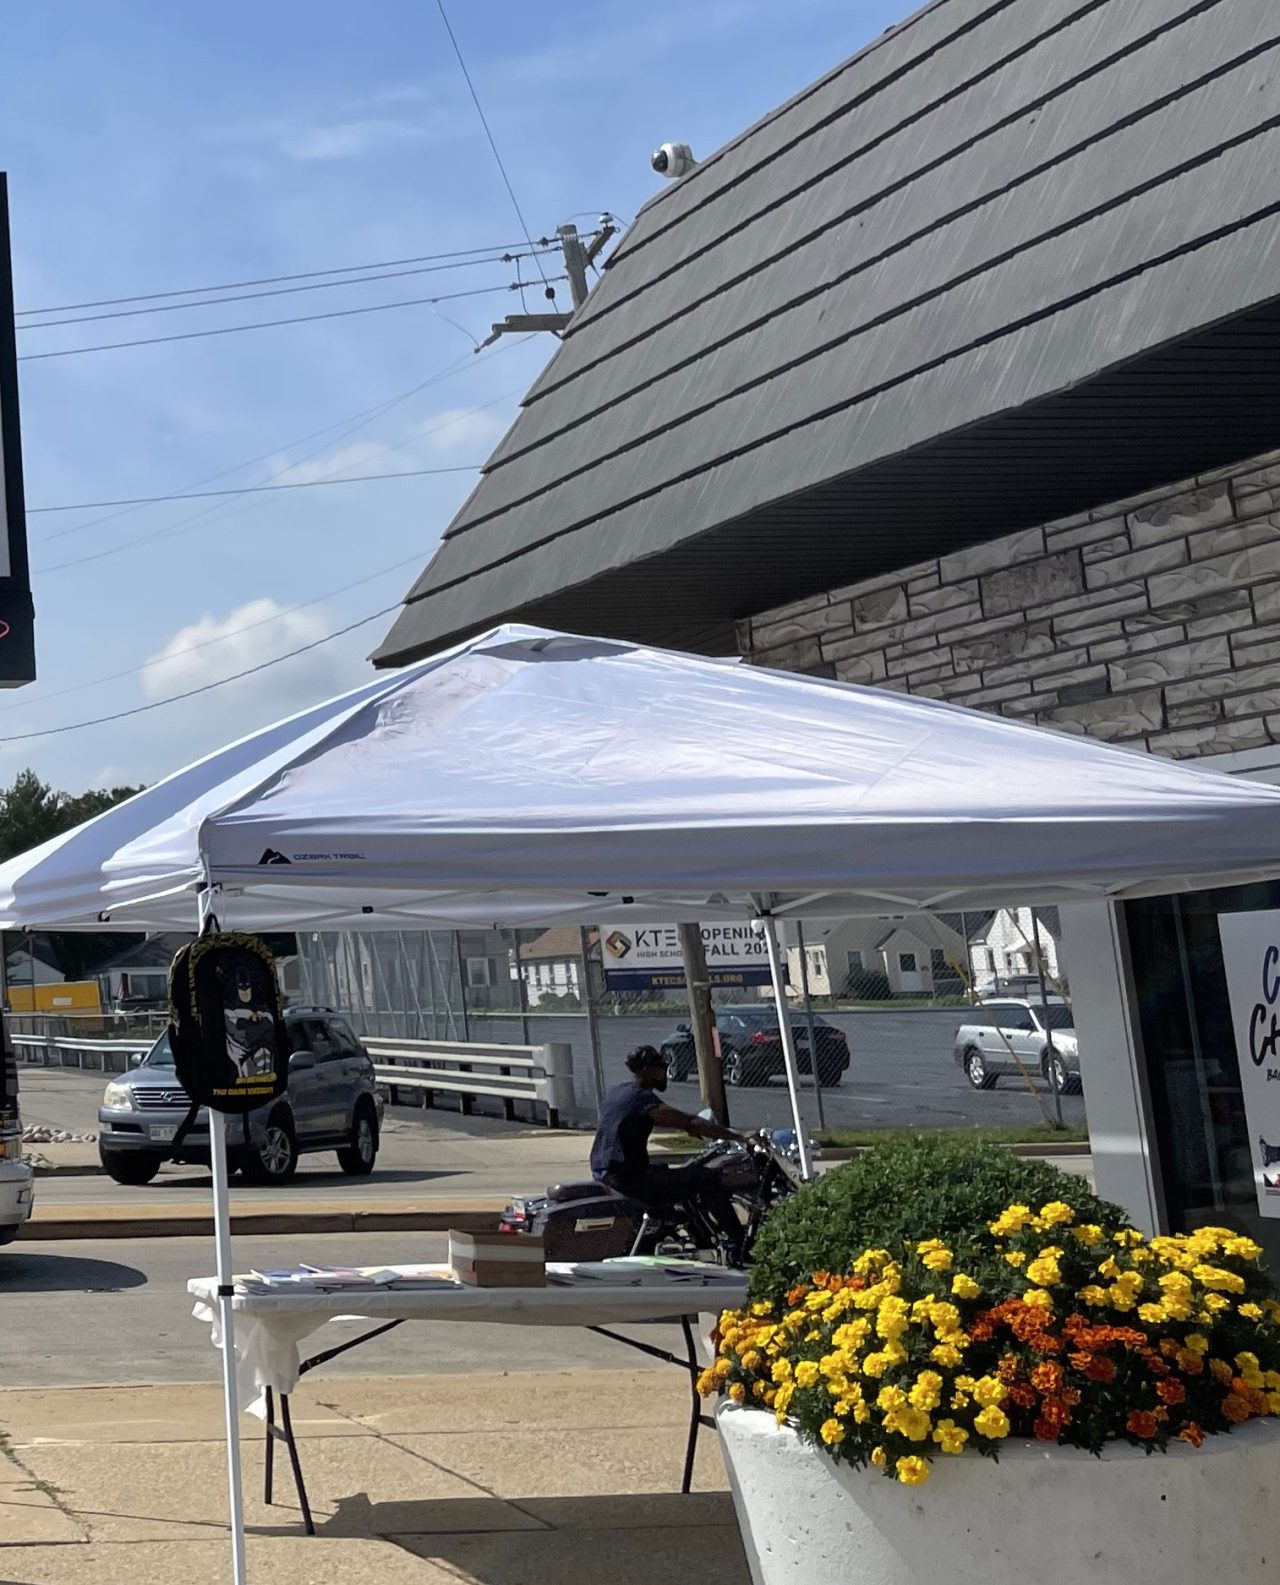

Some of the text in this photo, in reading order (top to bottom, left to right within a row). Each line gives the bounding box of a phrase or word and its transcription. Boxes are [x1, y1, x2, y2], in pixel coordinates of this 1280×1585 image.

[634, 929, 677, 948] KTE
[659, 950, 683, 959] SCHO
[703, 941, 782, 957] FALL 202
